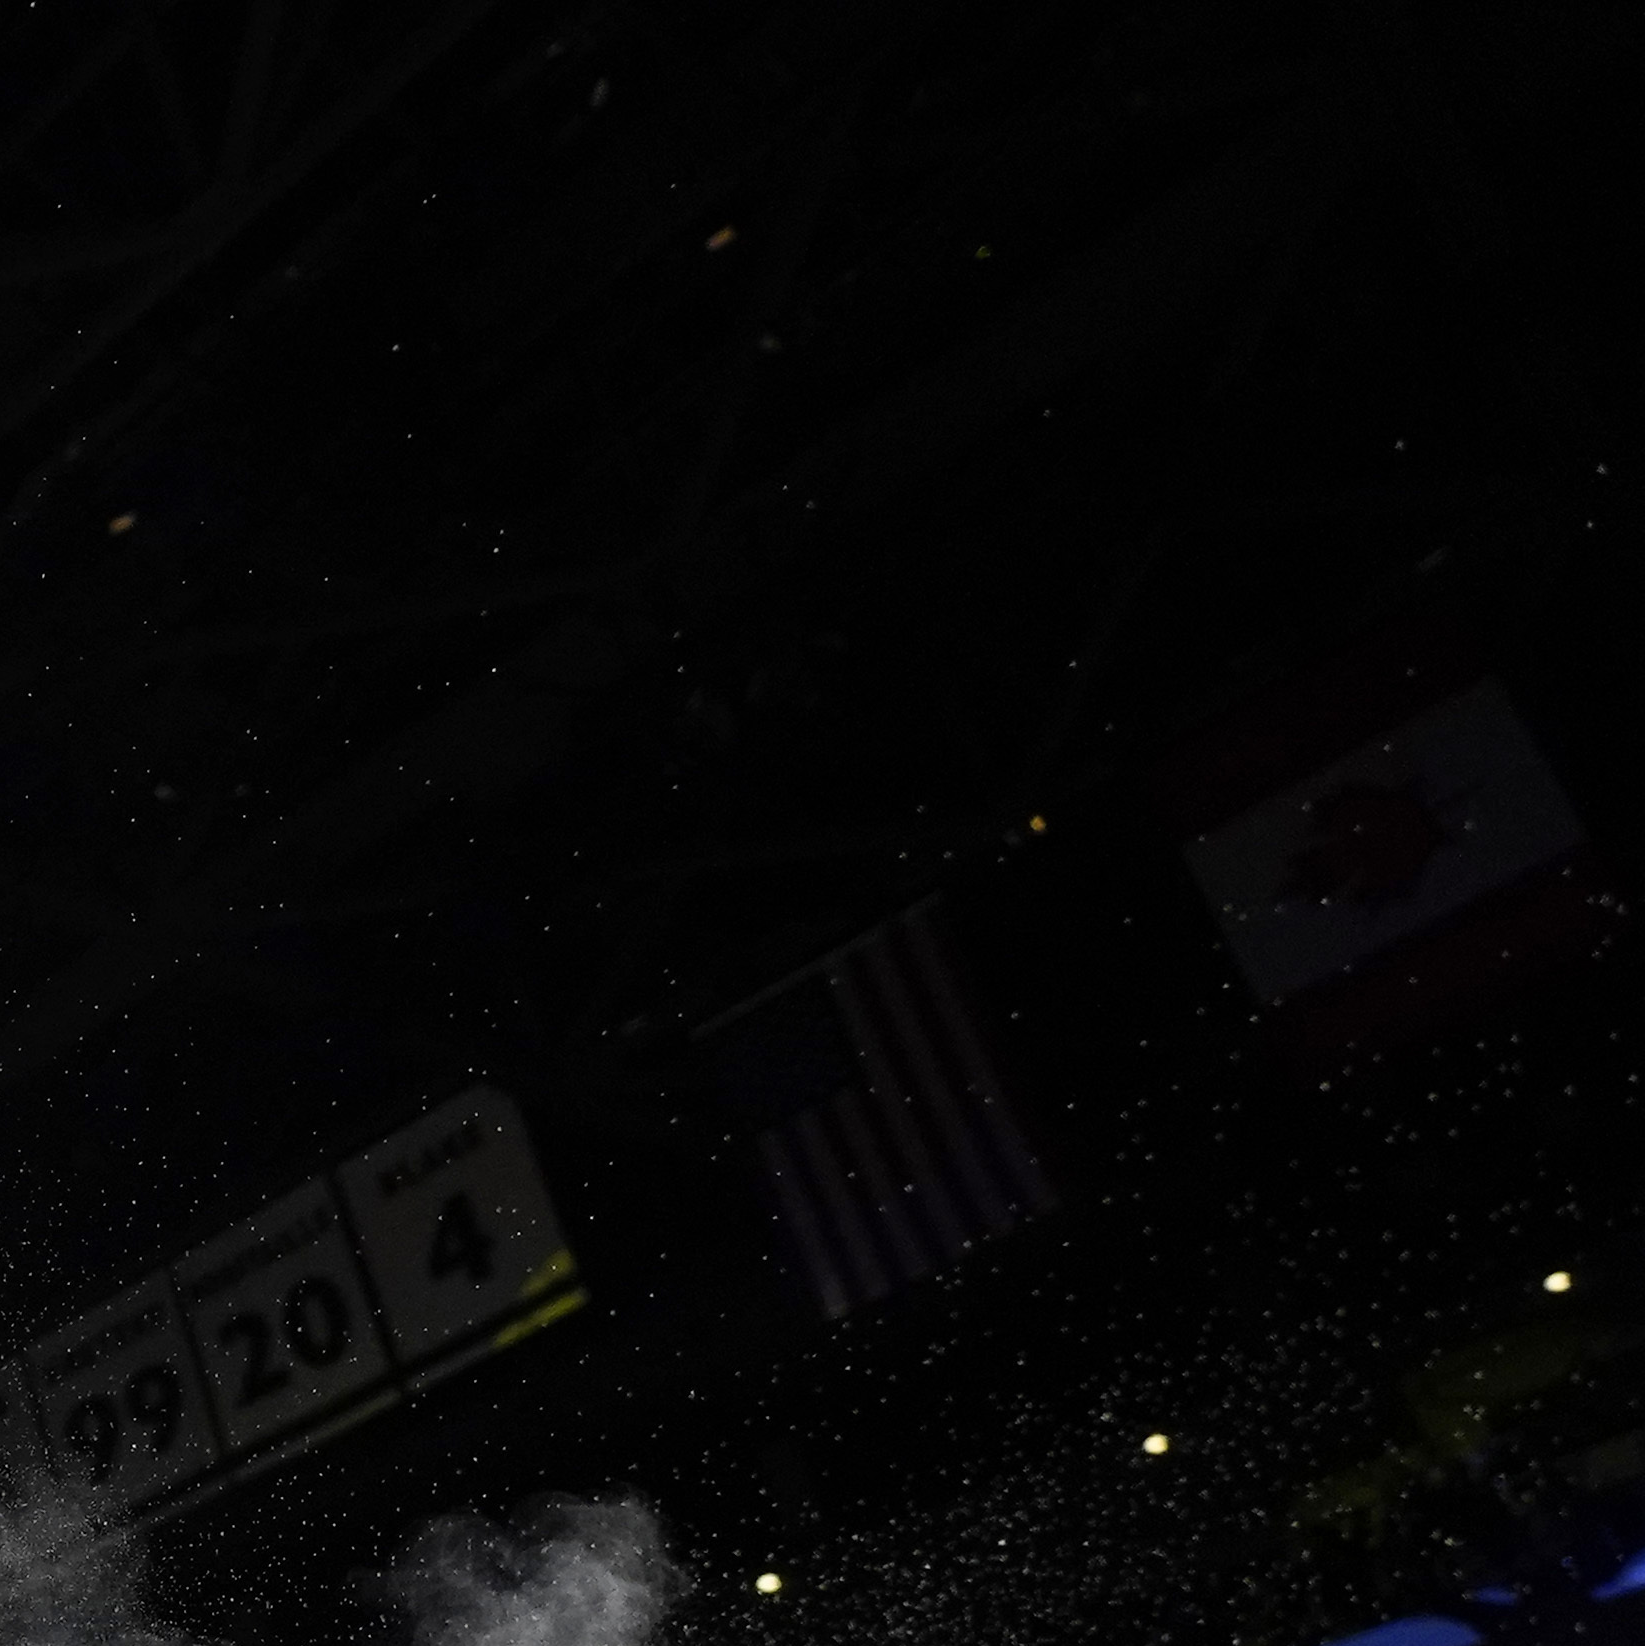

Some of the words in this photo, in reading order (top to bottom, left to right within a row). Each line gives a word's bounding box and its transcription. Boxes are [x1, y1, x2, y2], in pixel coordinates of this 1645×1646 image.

[430, 1191, 497, 1288] 4
[219, 1278, 352, 1409] 20
[63, 1364, 182, 1488] 99
